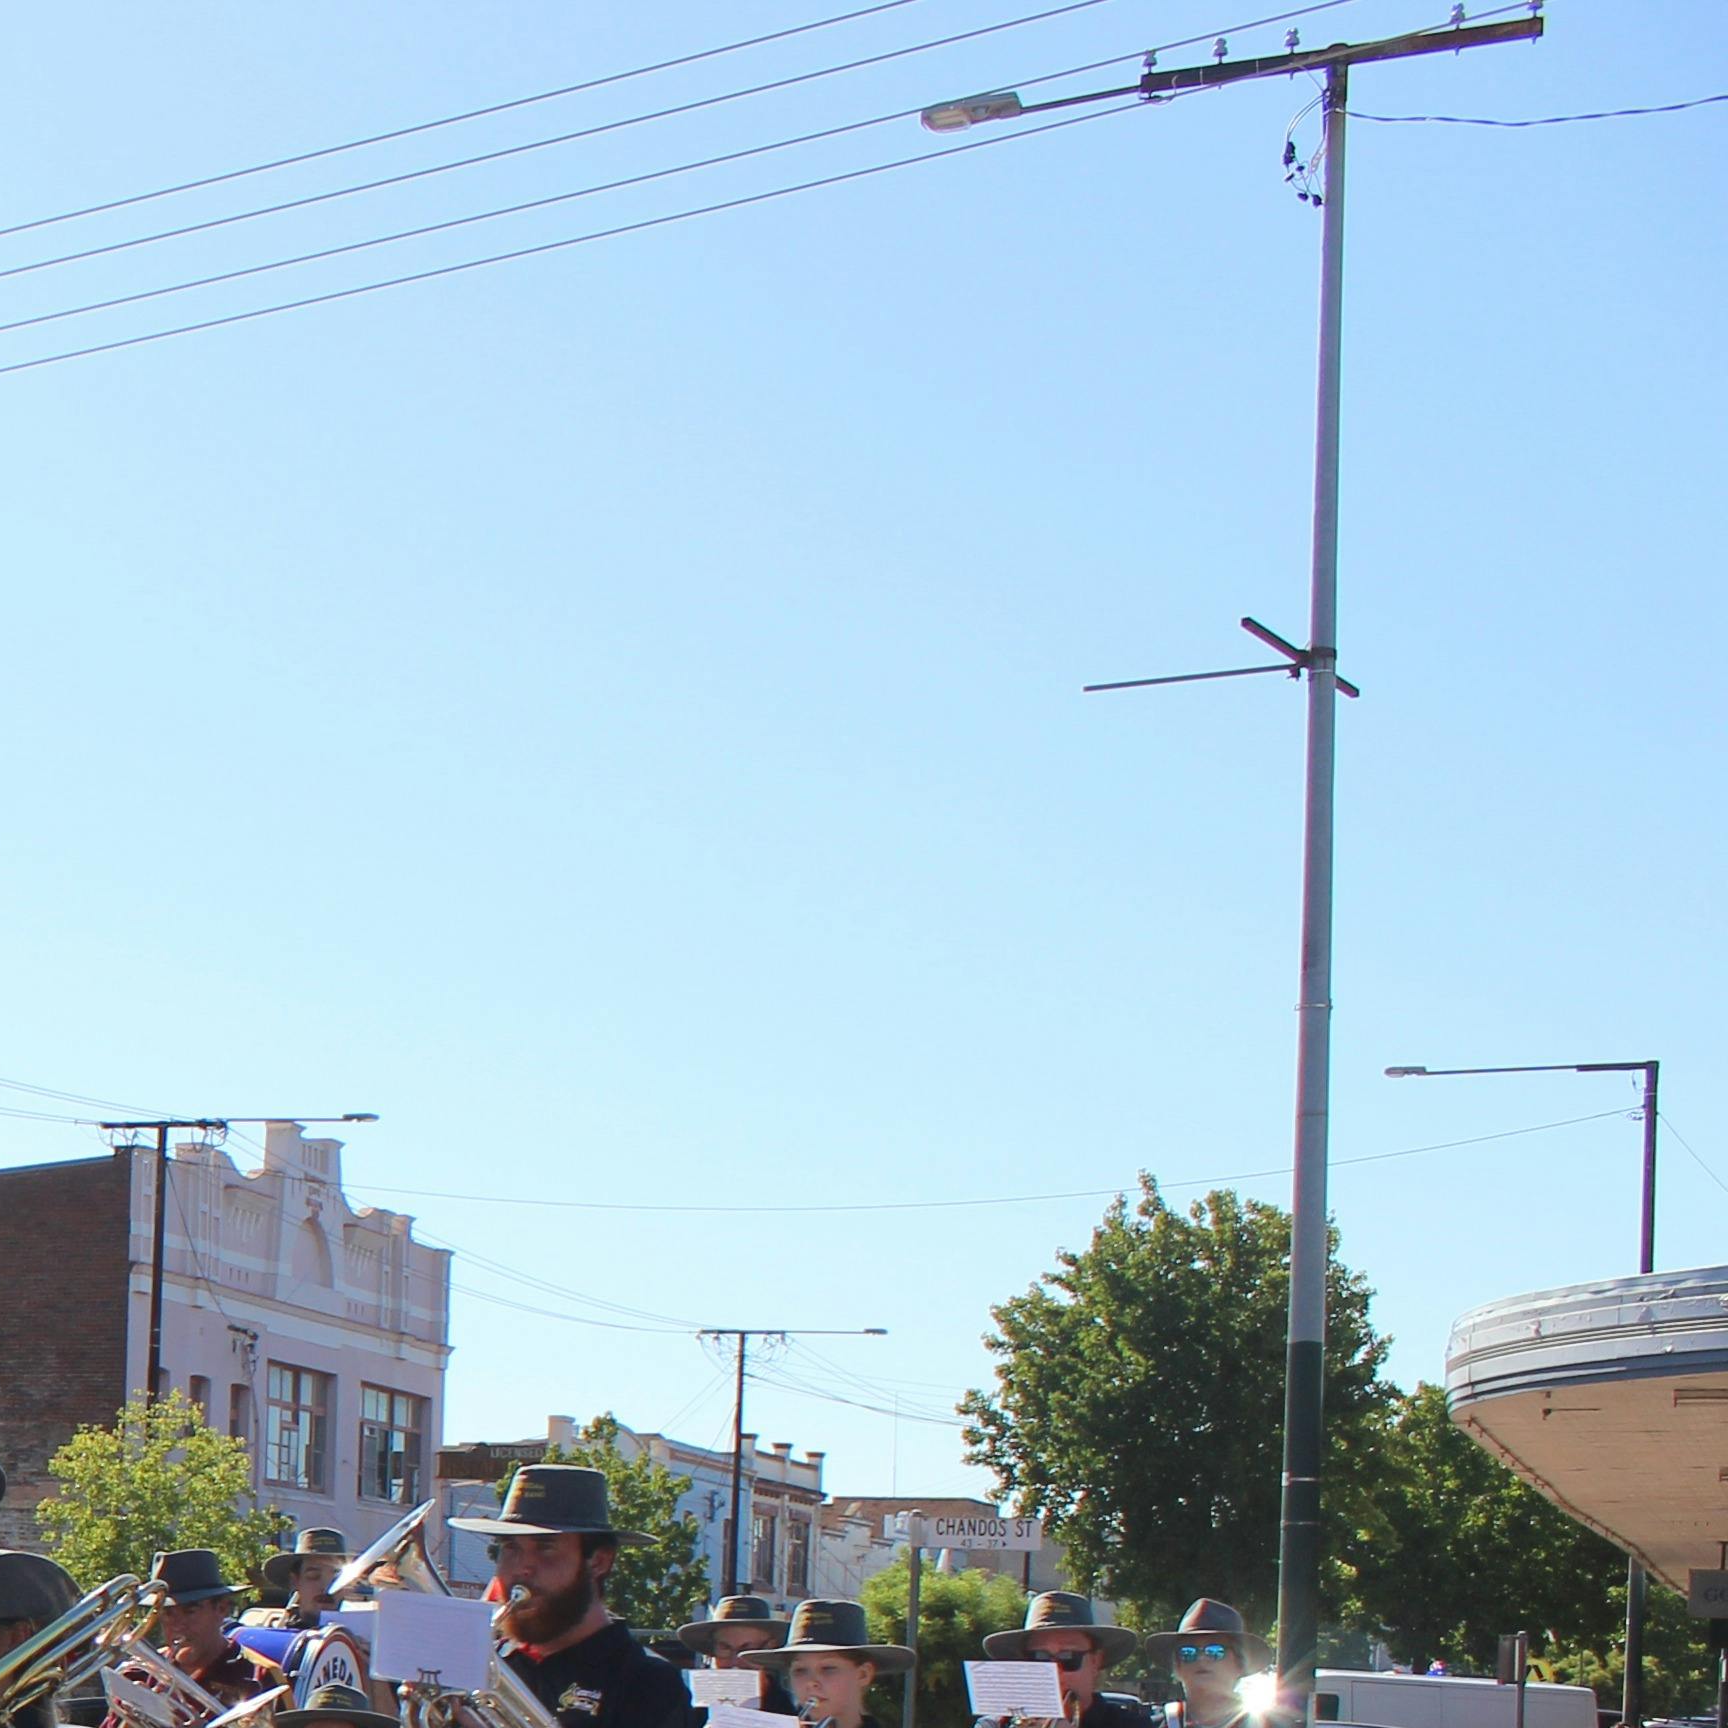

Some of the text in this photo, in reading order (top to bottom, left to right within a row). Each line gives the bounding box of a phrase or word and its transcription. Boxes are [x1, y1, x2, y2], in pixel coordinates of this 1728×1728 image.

[490, 1446, 544, 1459] LICENSED
[935, 1518, 1033, 1537] CHANDOS ST
